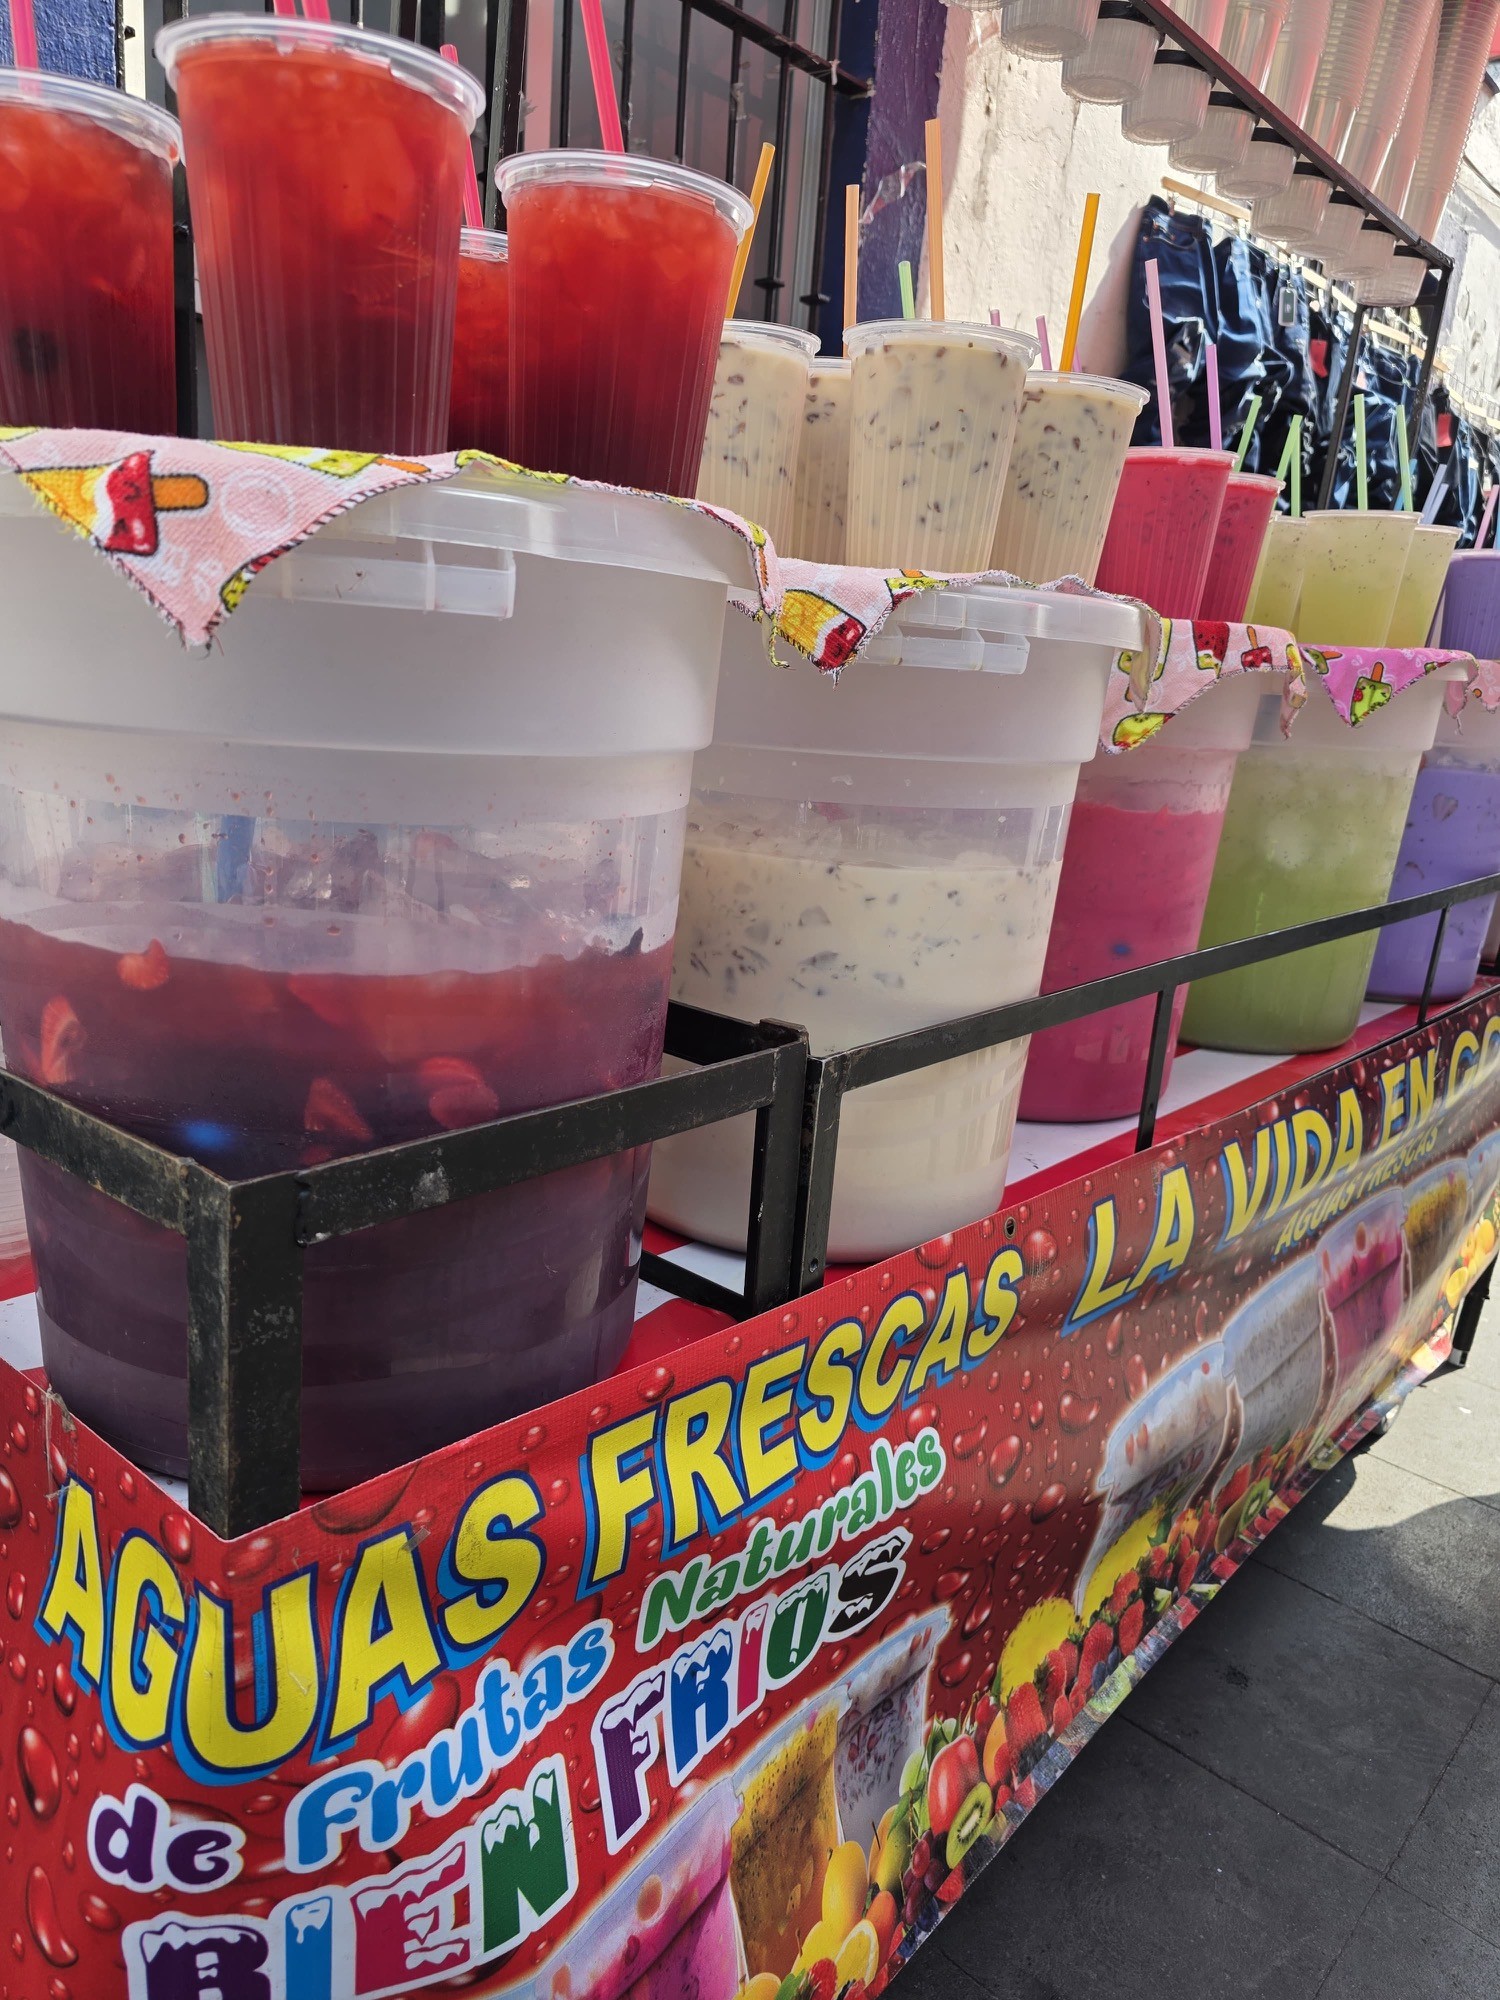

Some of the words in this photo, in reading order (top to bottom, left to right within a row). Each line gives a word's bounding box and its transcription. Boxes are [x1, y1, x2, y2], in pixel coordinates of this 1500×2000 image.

[37, 1470, 548, 1780] AGUAS
[581, 1245, 1024, 1593] FRESCAS
[1066, 1162, 1197, 1333] LA
[1219, 1087, 1364, 1250] VIDA
[1375, 1047, 1437, 1152] EN
[1273, 1171, 1363, 1257] AGUAS
[1356, 1117, 1444, 1200] FRESCAS
[91, 1788, 237, 1888] de
[640, 1431, 942, 1646] Naturales
[138, 1768, 568, 2000] BIEN
[601, 1534, 906, 1842] FRIOS
